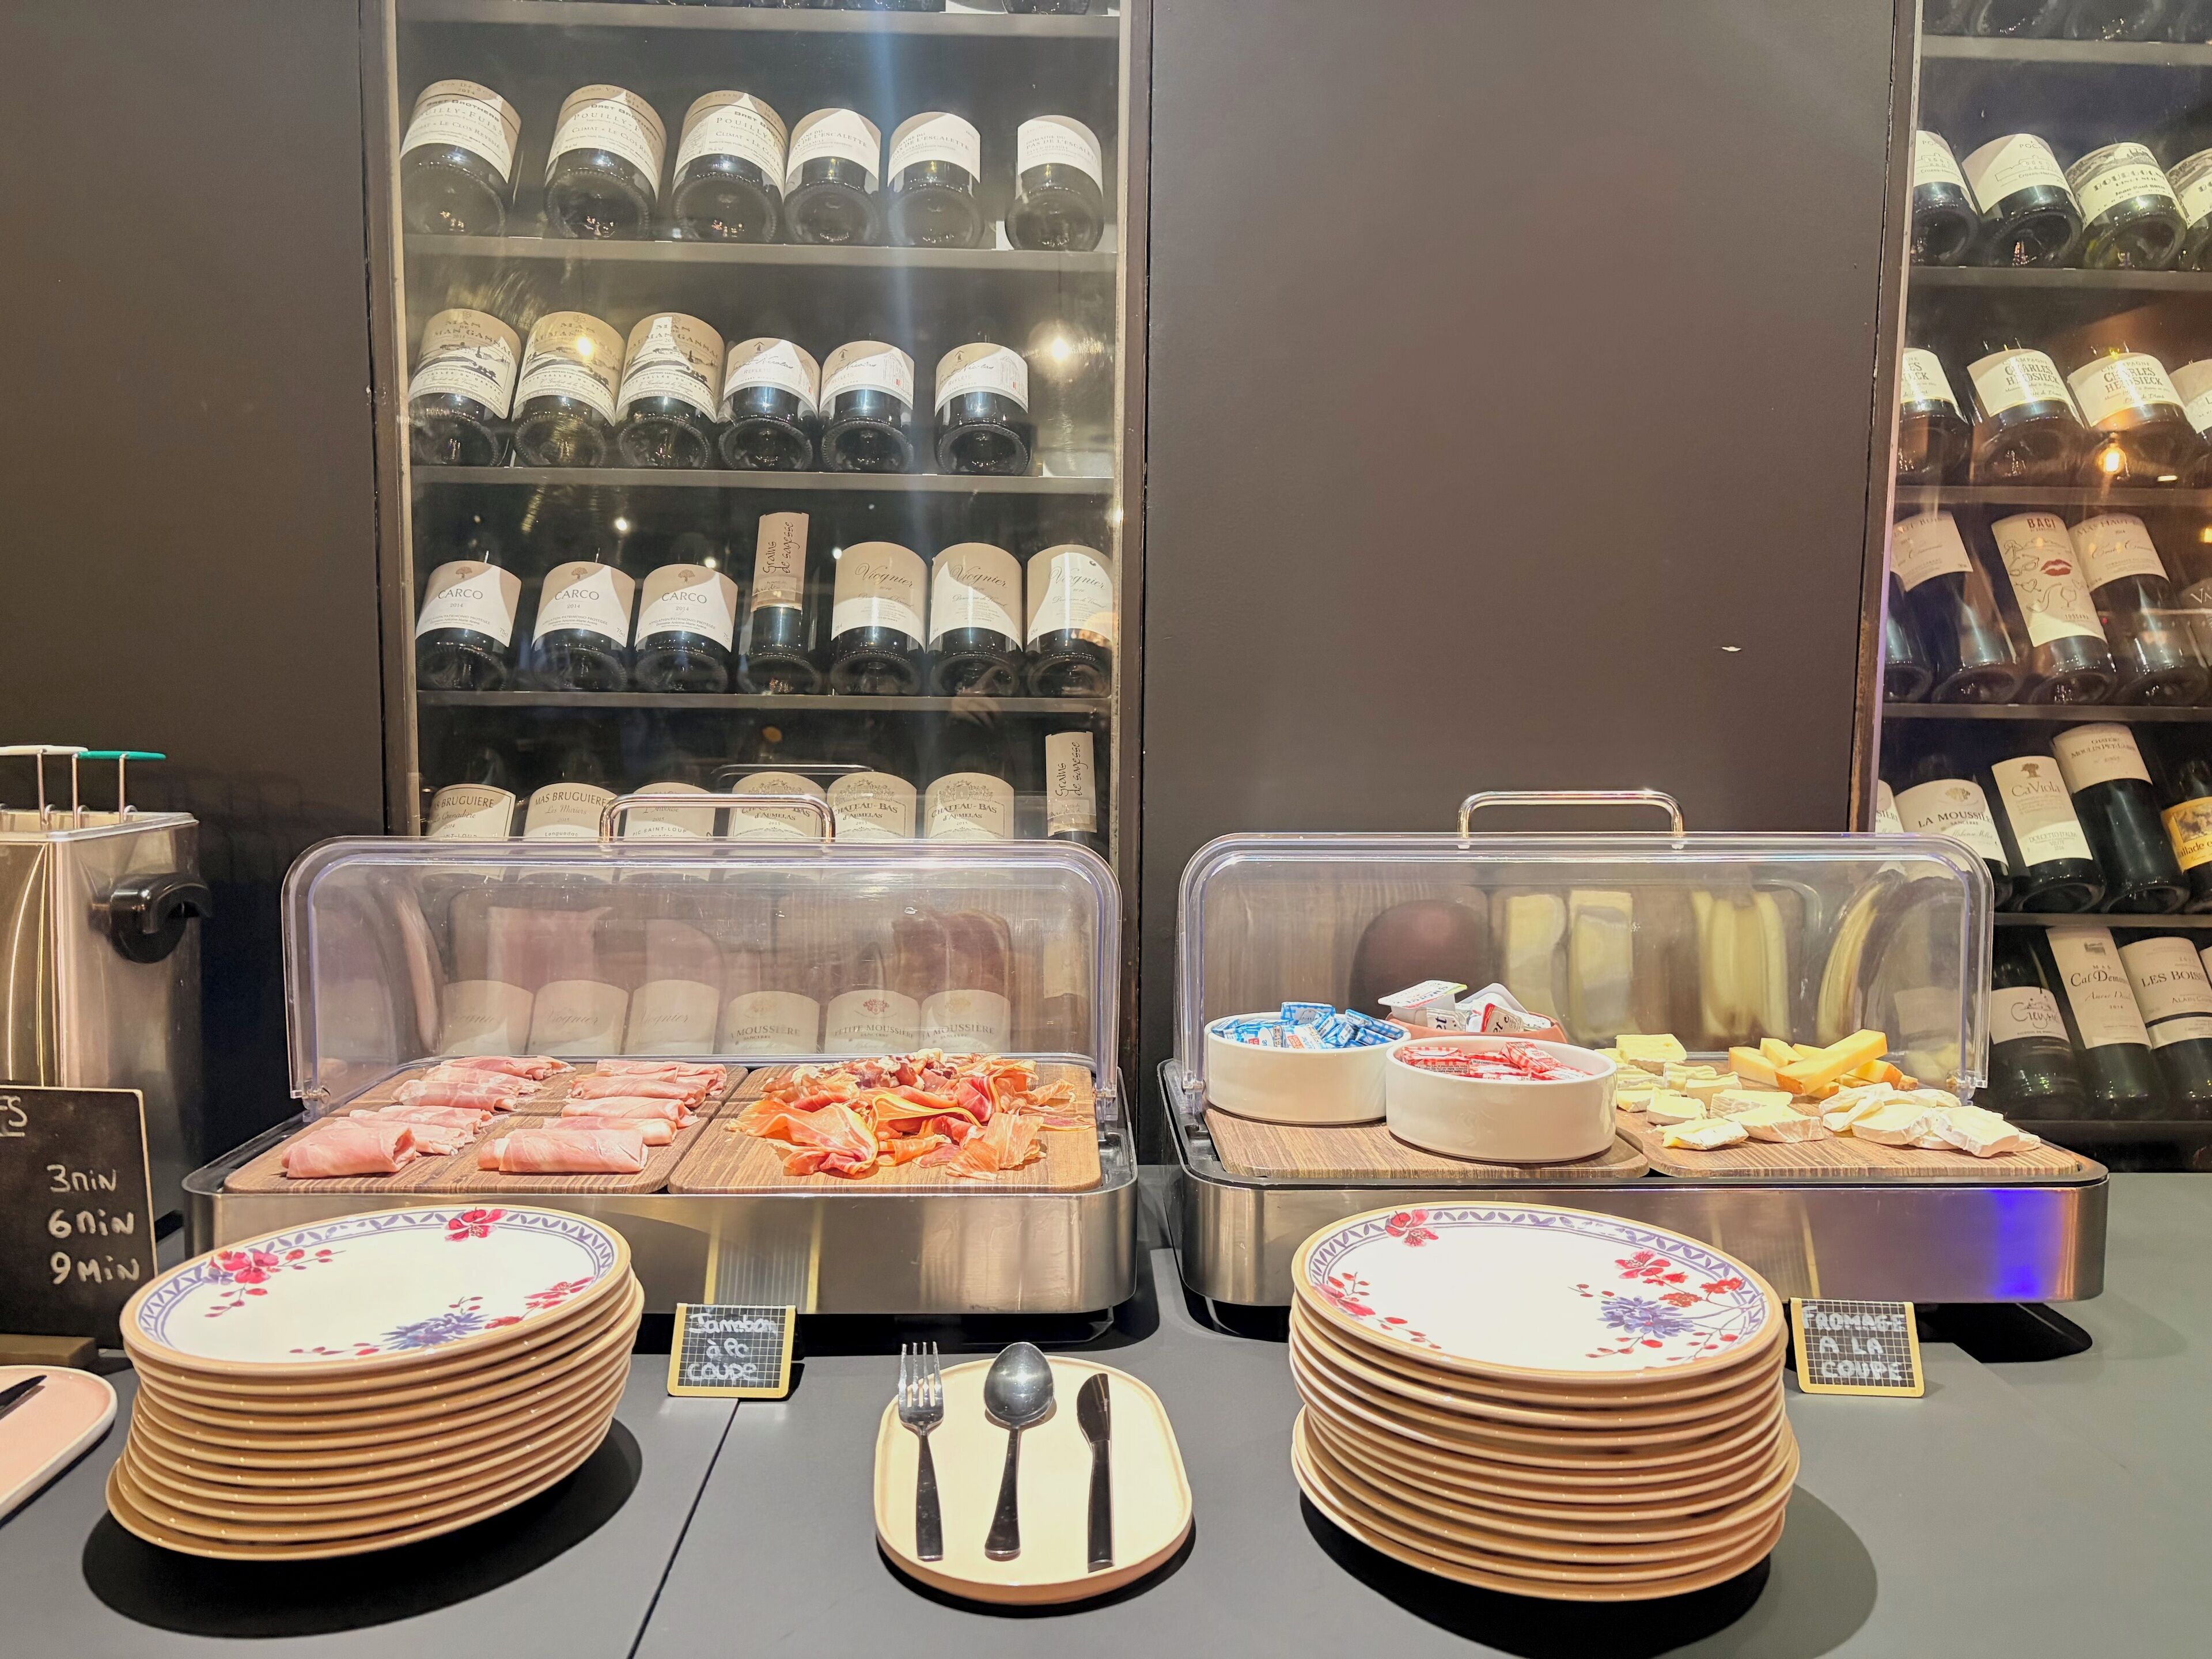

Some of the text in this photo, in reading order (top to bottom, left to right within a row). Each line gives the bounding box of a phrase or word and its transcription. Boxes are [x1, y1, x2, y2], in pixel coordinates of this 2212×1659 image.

[452, 99, 499, 122] BROTHERS
[734, 111, 757, 122] BRET
[715, 131, 743, 140] CLIMAT
[2027, 518, 2056, 529] BACI
[782, 521, 800, 559] sagesse
[855, 562, 914, 588] Viognier
[950, 564, 1007, 589] Viognier
[438, 588, 483, 600] CARCO
[554, 589, 600, 600] CARCO
[661, 591, 707, 604] CARCO
[1069, 741, 1089, 797] de sagesse
[441, 796, 494, 808] BRUGUIERE
[535, 791, 607, 807] MAS BRUGUIERE
[755, 811, 796, 821] d'AUMELAS
[843, 812, 883, 821] d'AUMELAS
[943, 813, 983, 821] d'AUMELAS
[1918, 816, 1934, 828] LA
[643, 825, 687, 834] SAINT-LOUP
[2070, 972, 2091, 987] Cal
[2141, 974, 2168, 987] LES
[834, 1025, 863, 1036] PETITE
[1802, 1305, 1906, 1332] FROMAGE
[1819, 1335, 1884, 1355] A LA
[1821, 1359, 1903, 1381] COUPE
